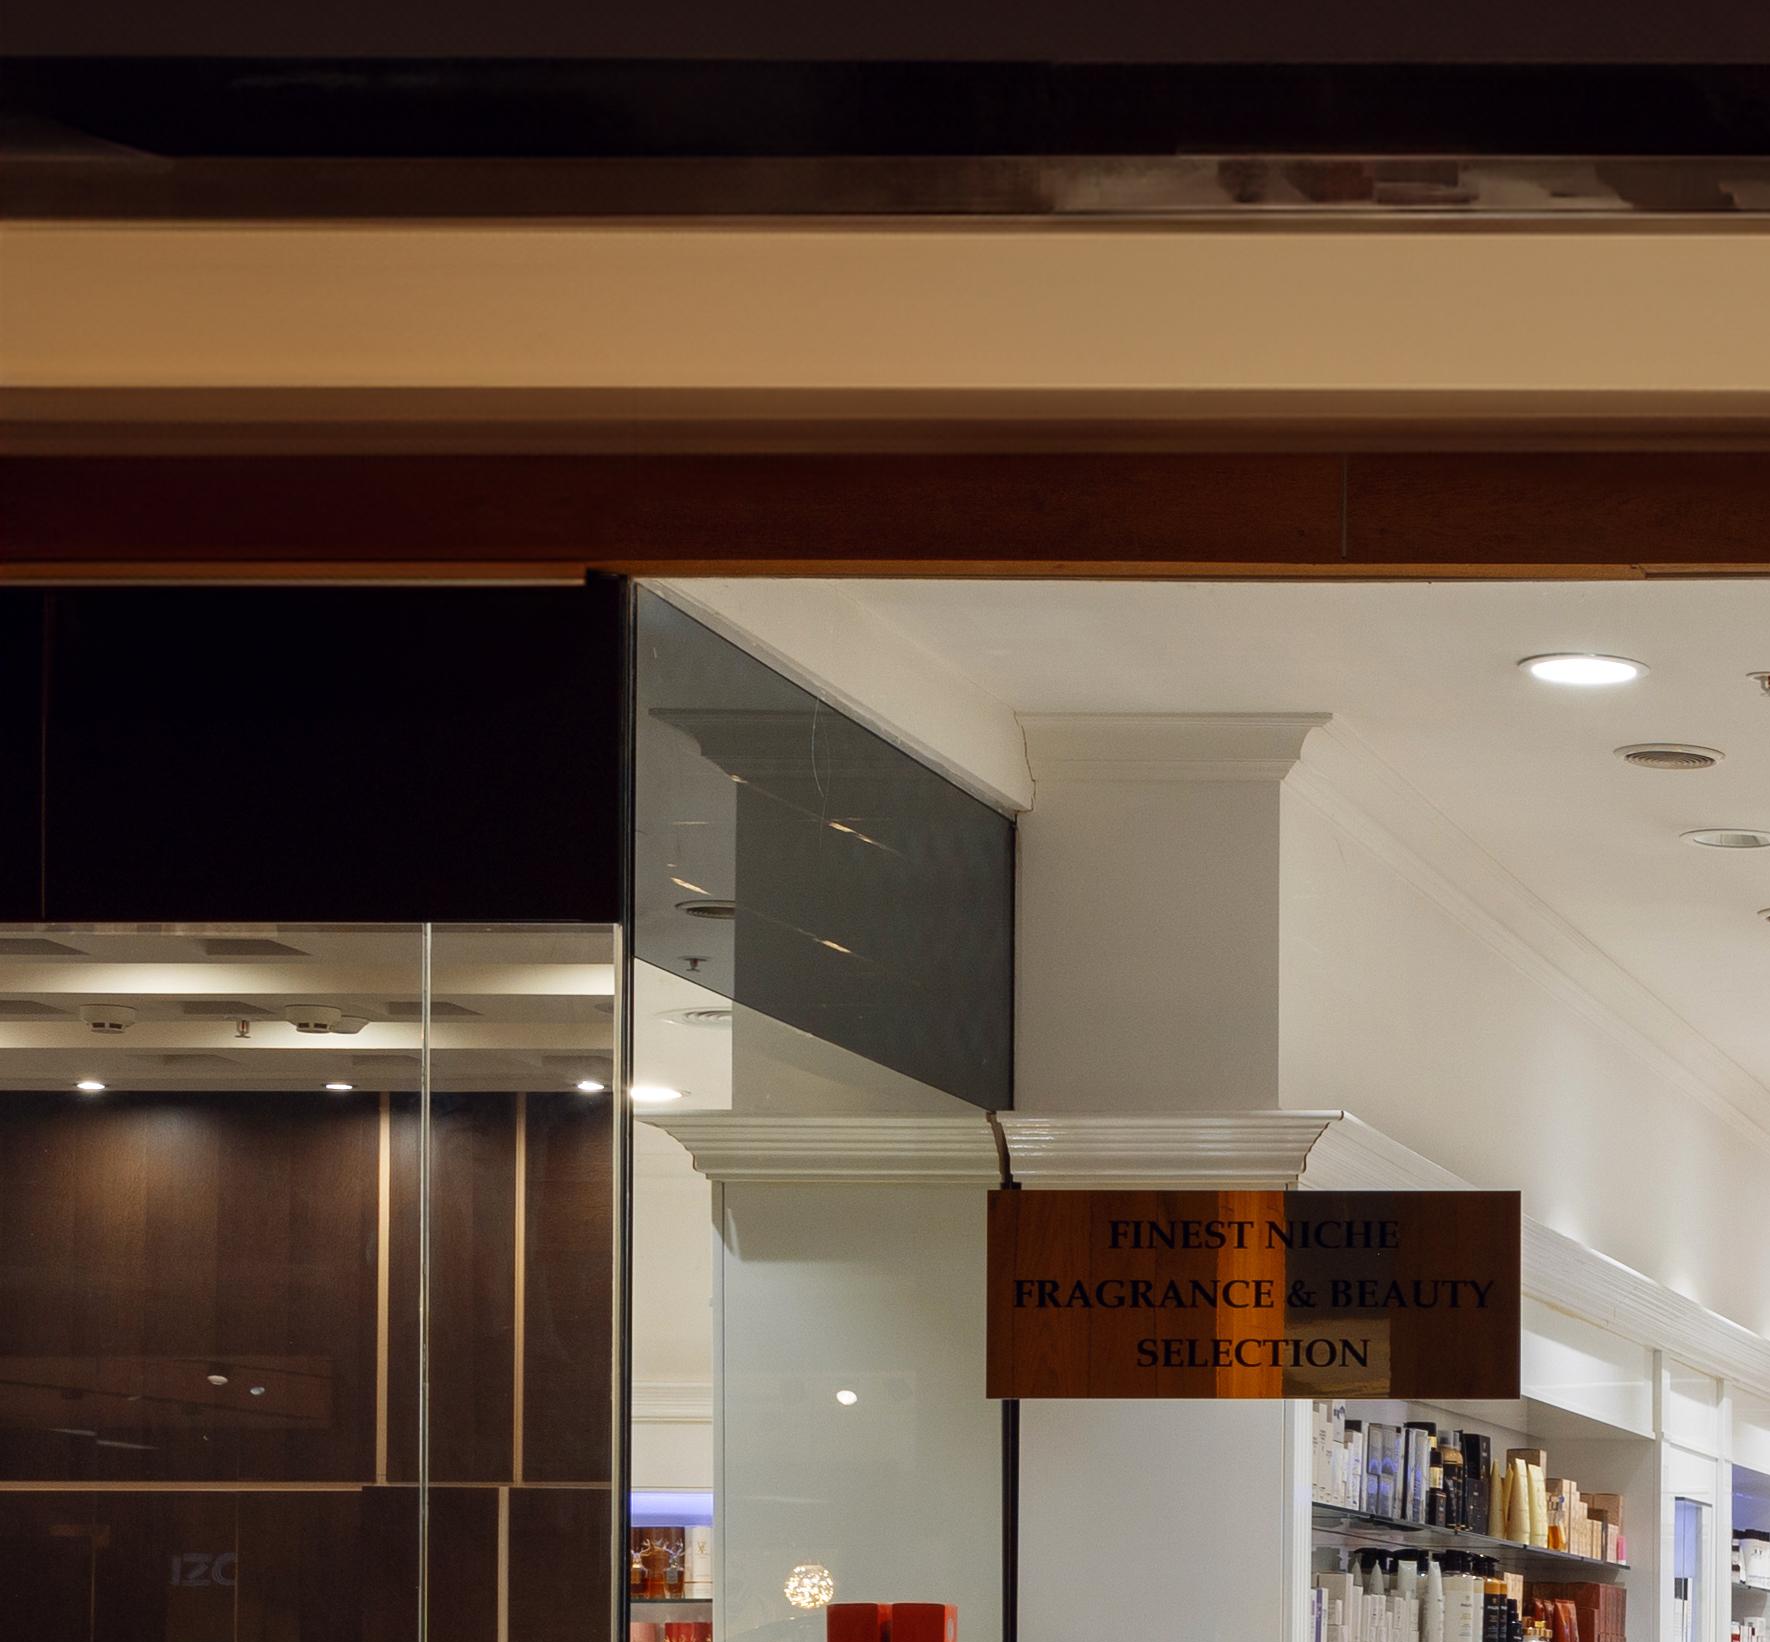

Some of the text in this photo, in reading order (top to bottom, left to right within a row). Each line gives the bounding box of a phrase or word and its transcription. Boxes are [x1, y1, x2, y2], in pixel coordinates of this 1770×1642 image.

[1108, 1219, 1399, 1249] FINEST NICHE
[1013, 1279, 1496, 1310] FRAGRANCE & BEAUTY
[1136, 1337, 1371, 1369] SELECTION
